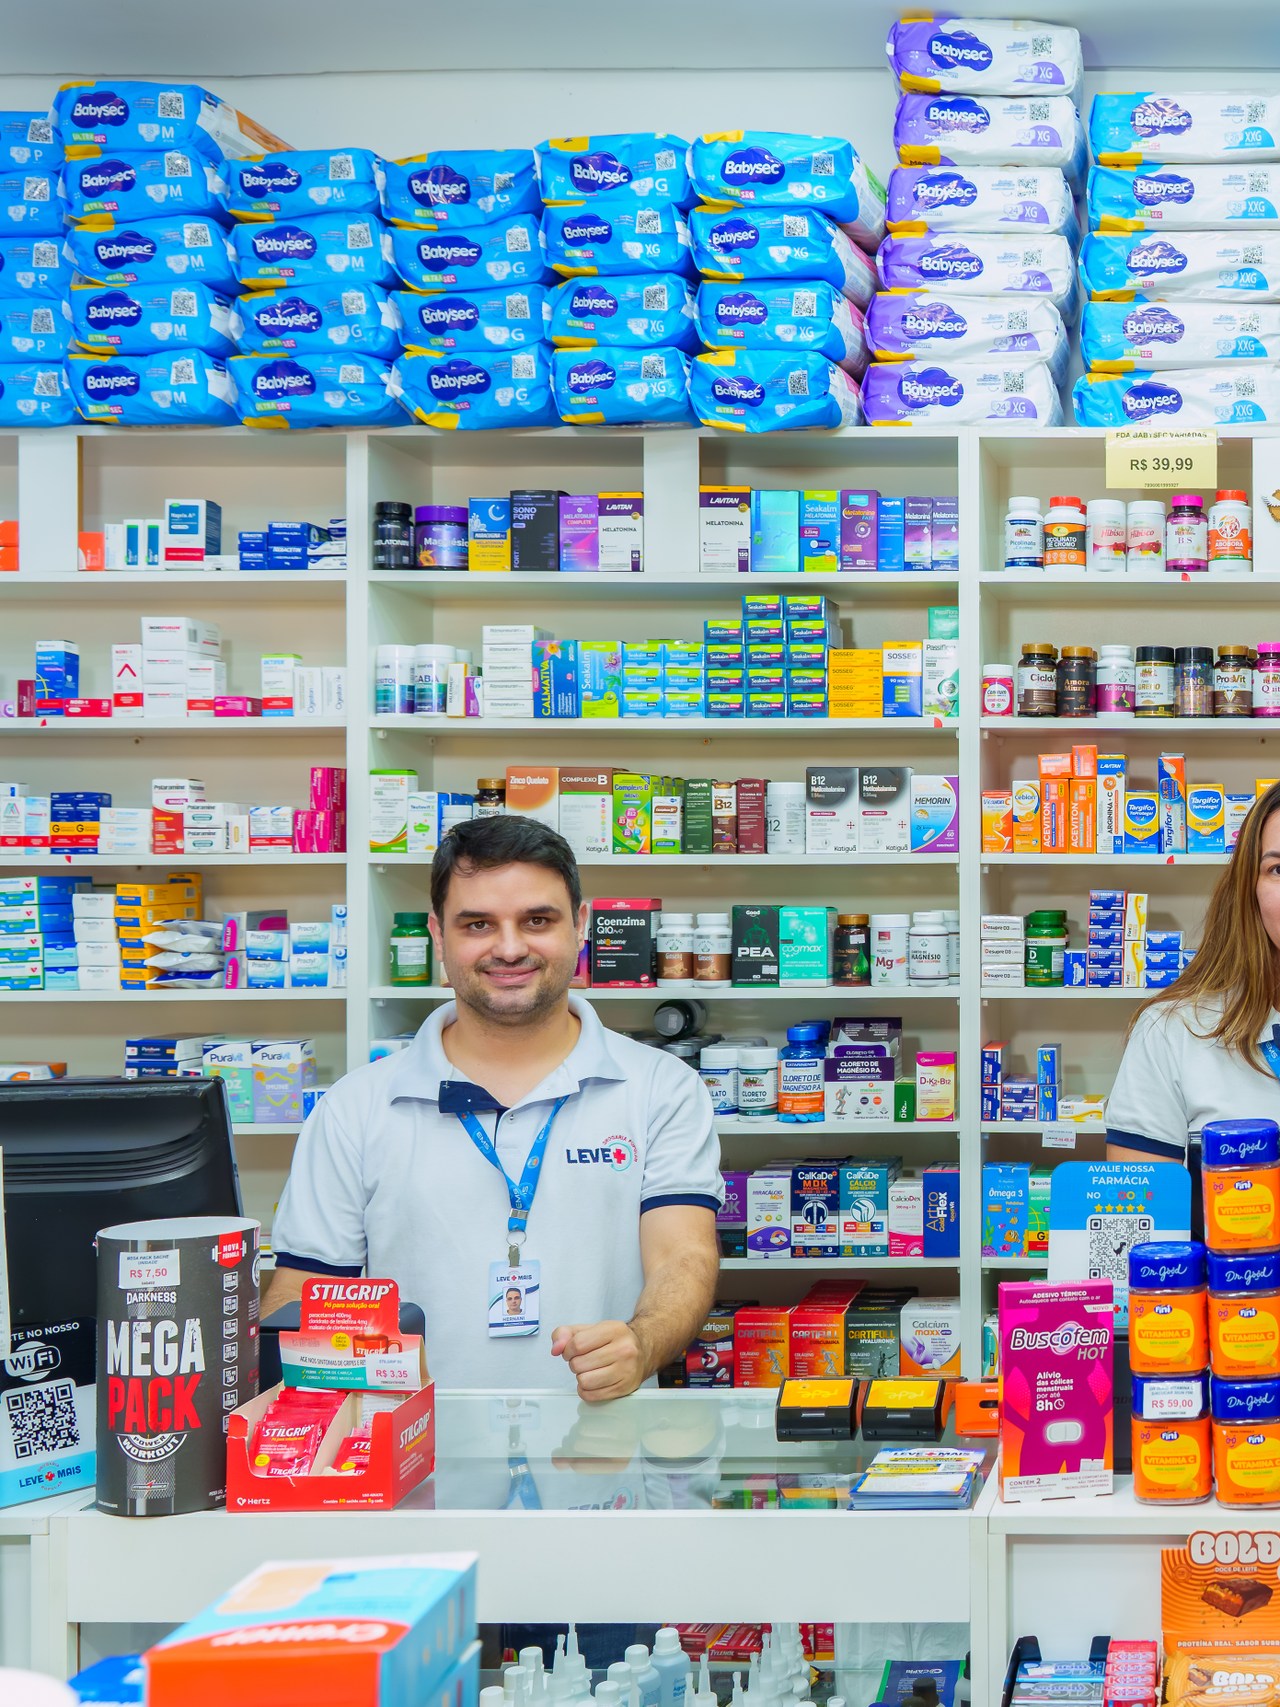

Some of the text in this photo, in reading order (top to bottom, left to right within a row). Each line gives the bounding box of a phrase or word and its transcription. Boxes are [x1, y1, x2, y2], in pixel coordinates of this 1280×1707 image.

[932, 42, 990, 63] Babysec
[1040, 66, 1053, 79] XG
[74, 101, 126, 119] Babysec
[573, 165, 629, 184] Babysec
[725, 161, 781, 178] Babysec
[243, 172, 299, 188] Babysec
[564, 226, 611, 240] Babysec
[98, 242, 154, 260] Babysec
[922, 256, 980, 274] Babysec
[717, 303, 765, 319] Babysec
[1237, 340, 1255, 353] XXG
[86, 374, 138, 391] Babysec
[430, 372, 486, 389] Babysec
[902, 381, 958, 396] Babysec
[1127, 395, 1178, 409] Babysec
[1130, 457, 1194, 473] R$ 39,99
[513, 506, 537, 514] SONO
[606, 503, 633, 511] LAVITAN
[706, 519, 744, 527] MELATONINA
[541, 659, 550, 716] CALMATIVA
[597, 774, 608, 785] B
[811, 775, 825, 786] B12
[863, 774, 878, 785] B12
[714, 798, 732, 810] B12
[914, 797, 951, 805] MEMORIN
[1190, 796, 1220, 806] Targifor
[1128, 803, 1155, 813] Targifor
[1071, 802, 1079, 848] ACEVITON
[596, 915, 646, 928] Coenzima
[596, 926, 613, 935] Q10
[737, 946, 774, 958] PEA
[876, 957, 893, 970] Mg
[837, 1066, 870, 1074] MAGNÉSIO
[566, 1147, 614, 1164] LEVE
[846, 1171, 880, 1180] CalKaDe
[1087, 1165, 1155, 1173] AVALIE NOSSA
[798, 1171, 834, 1181] CalKaDe
[1092, 1176, 1150, 1185] FARMÁCIA
[803, 1179, 828, 1188] MDK
[989, 1188, 1024, 1199] Ômega 3
[1086, 1191, 1101, 1199] NO
[926, 1191, 939, 1232] Artro
[1220, 1206, 1257, 1215] VITAMINA
[129, 1267, 168, 1280] R$ 7,50
[309, 1283, 390, 1301] STILGRIP
[1061, 1290, 1087, 1298] TÉRMICO
[332, 1302, 344, 1310] para
[344, 1302, 367, 1310] solução
[26, 1322, 80, 1338] NO NOSSO
[912, 1320, 949, 1329] Calcium
[848, 1330, 896, 1339] CARTIFULL
[1011, 1326, 1109, 1351] Buscofem
[107, 1317, 206, 1377] MEGA
[1077, 1346, 1107, 1361] HOT
[376, 1369, 408, 1379] R$ 3,35
[1036, 1371, 1061, 1380] Alívio
[1050, 1378, 1073, 1386] cólicas
[107, 1374, 202, 1433] PACK
[1035, 1399, 1054, 1412] 8h
[1151, 1399, 1193, 1409] R$ 59,00
[262, 1425, 312, 1438] STILGRIP
[121, 1438, 179, 1460] WORKOUT
[19, 1465, 82, 1488] LEVE MAIS
[247, 1497, 270, 1505] Hertz
